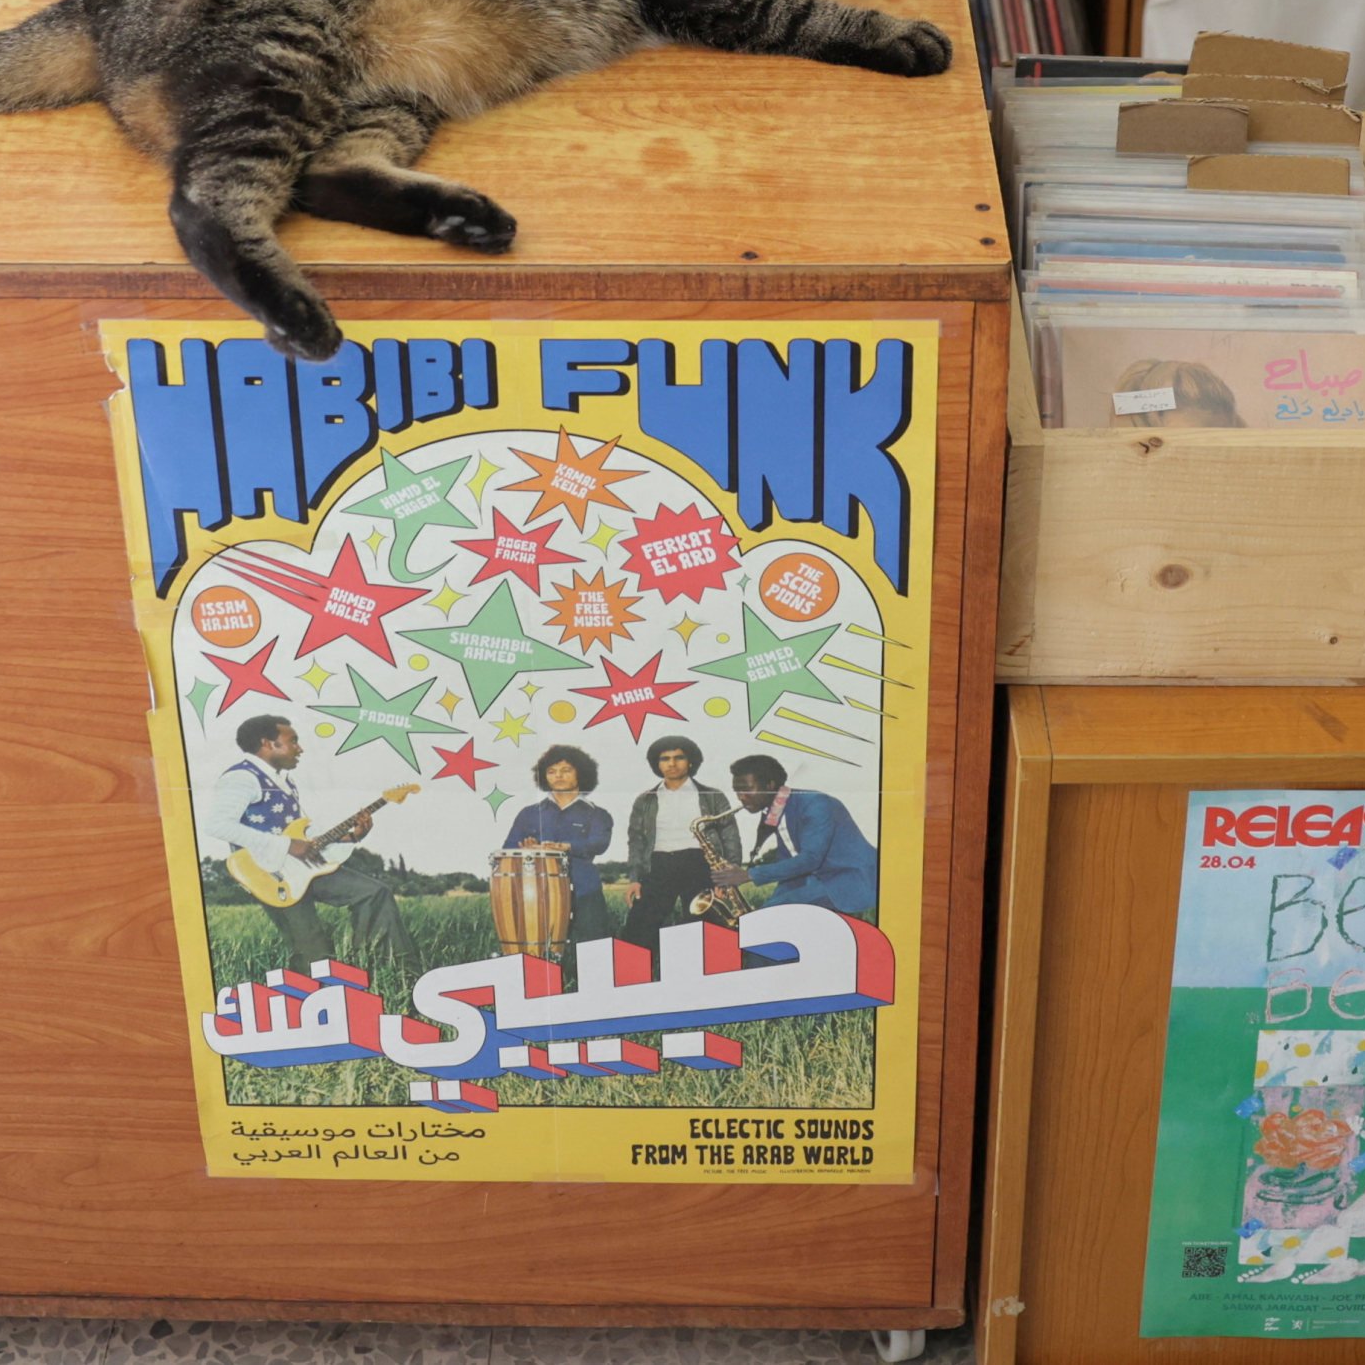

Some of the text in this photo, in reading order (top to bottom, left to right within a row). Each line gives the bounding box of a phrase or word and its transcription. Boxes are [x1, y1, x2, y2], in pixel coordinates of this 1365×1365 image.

[1263, 348, 1365, 397] صباح
[127, 338, 913, 598] HABIBI FUNK
[554, 462, 597, 491] KAMAL
[378, 476, 442, 511] HAMID EL
[549, 475, 589, 501] KEILA
[393, 491, 442, 520] SHAERI
[494, 547, 537, 565] FAKHR
[496, 535, 538, 554] ROGER
[640, 528, 713, 560] FERKAT
[650, 546, 718, 577] EL ARD
[797, 562, 825, 583] THE
[578, 590, 606, 603] THE
[778, 571, 824, 603] SCOR-
[200, 599, 248, 617] ISSAM
[328, 586, 377, 613] AHMED
[575, 602, 610, 615] FREE
[764, 583, 817, 616] PIONS
[201, 613, 255, 633] HAJALI
[323, 599, 372, 627] MALEK
[573, 614, 615, 628] MUSIC
[449, 631, 534, 655] SHARHABIL
[463, 646, 517, 665] AHMED
[746, 646, 795, 669] AHMED
[746, 656, 803, 683] BEN ALI
[610, 686, 656, 707] MAHA
[358, 708, 413, 730] FADOUL
[1199, 854, 1258, 870] 28.04
[379, 903, 896, 1114] حبيبي
[230, 1119, 486, 1143] مختارات موسيقية
[689, 1117, 875, 1141] ECLECTIC SOUNDS
[232, 1143, 461, 1168] من العالم العربي
[631, 1144, 875, 1166] FROM THE ARAB WORLD
